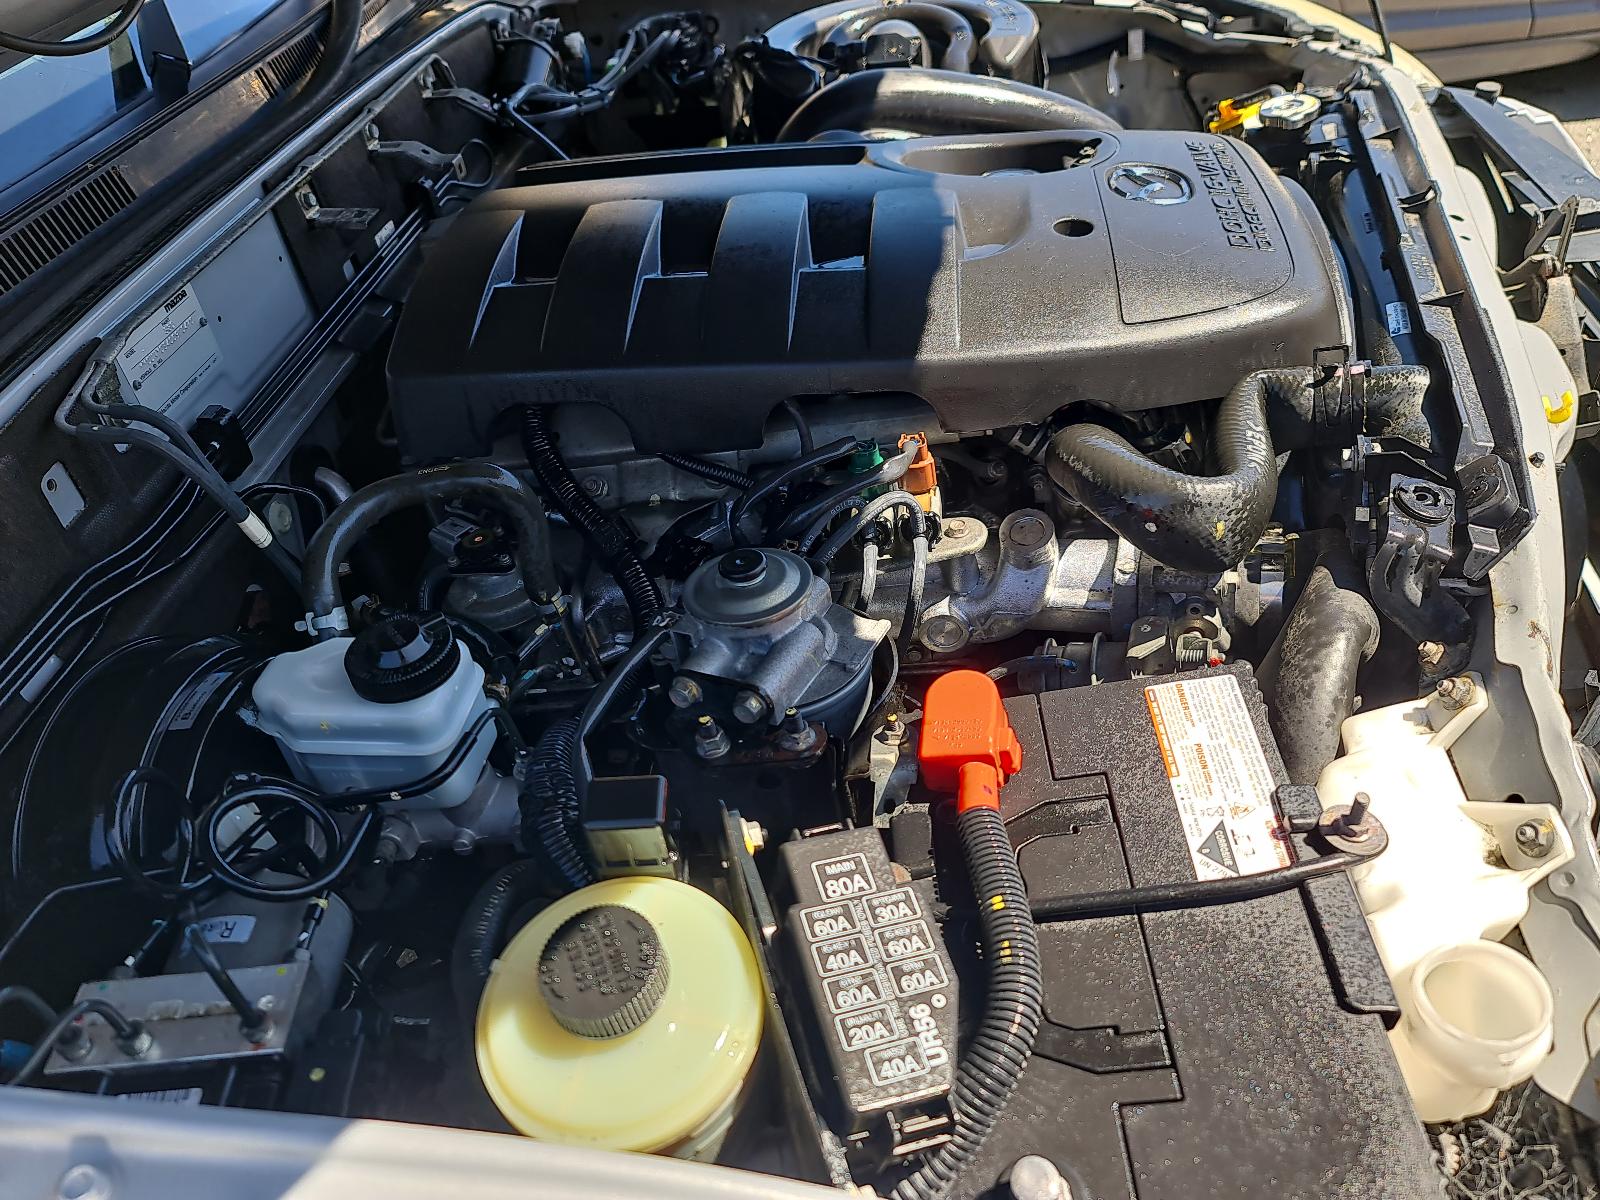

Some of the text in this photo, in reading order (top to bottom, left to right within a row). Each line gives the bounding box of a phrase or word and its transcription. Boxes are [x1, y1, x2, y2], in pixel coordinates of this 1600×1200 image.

[1211, 197, 1253, 250] DOHC
[1238, 200, 1276, 252] DIRECT
[1175, 683, 1190, 711] DANGER
[1194, 743, 1209, 770] POISON
[1214, 830, 1234, 866] CORROSIVE
[824, 873, 870, 898] 80A
[875, 901, 913, 923] 30A
[813, 915, 852, 937] 60A
[887, 935, 926, 957] 60A
[825, 949, 864, 971] 40A
[901, 969, 940, 992] 60A
[836, 984, 878, 1007] 60A
[848, 1021, 890, 1046] 20A
[909, 1003, 949, 1067] UR56
[880, 1054, 921, 1078] 40A
